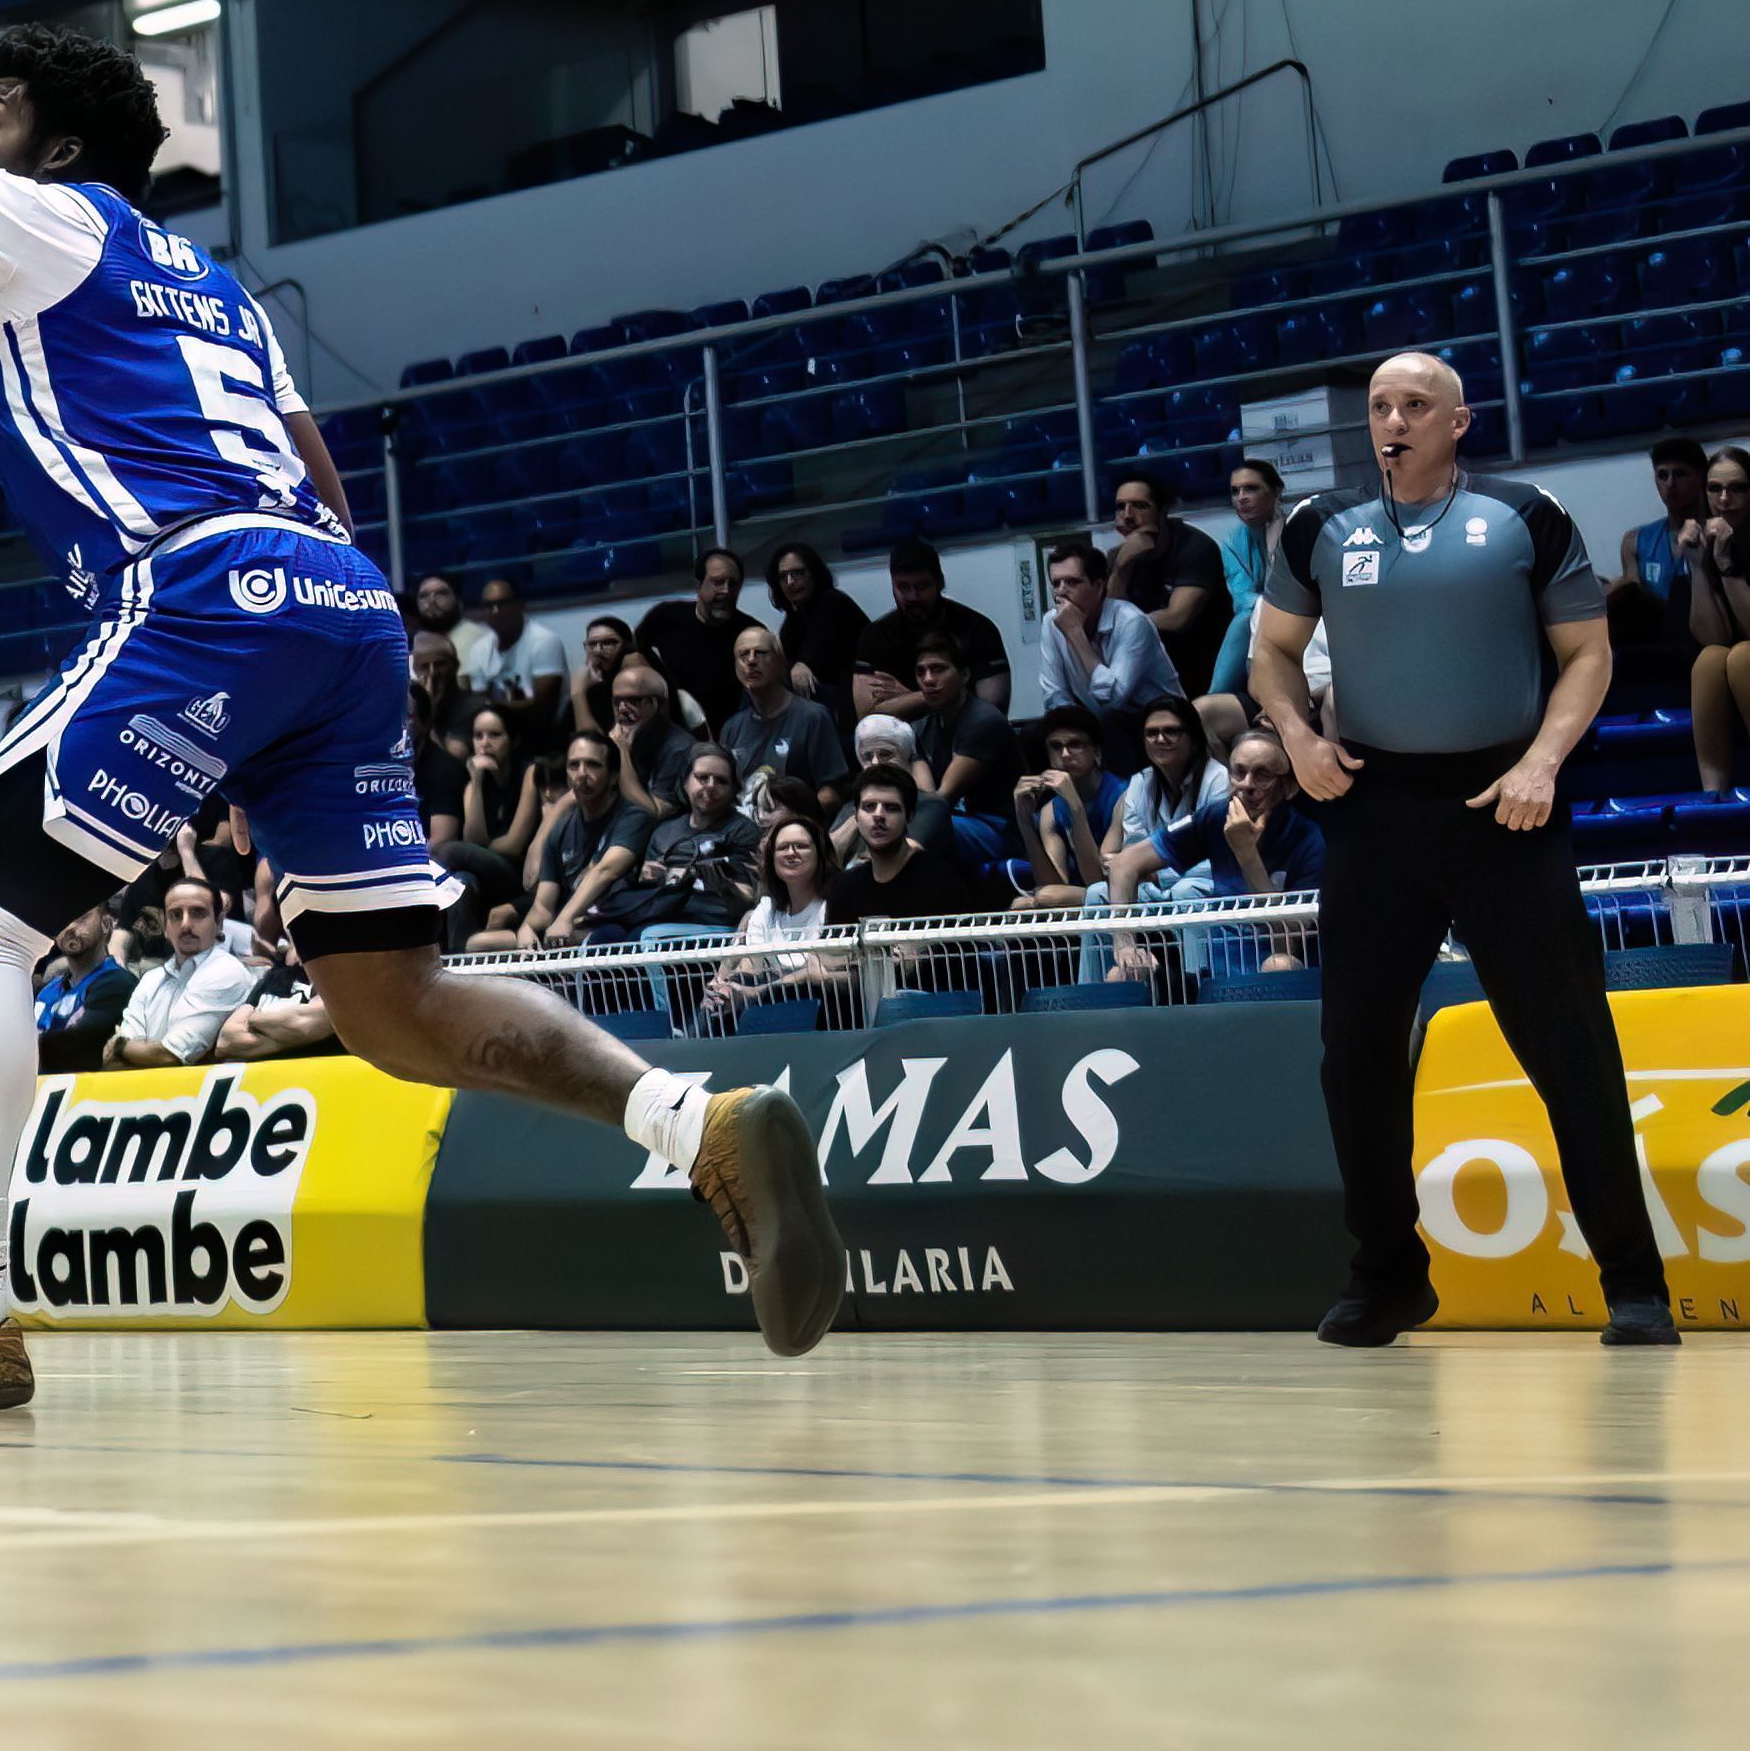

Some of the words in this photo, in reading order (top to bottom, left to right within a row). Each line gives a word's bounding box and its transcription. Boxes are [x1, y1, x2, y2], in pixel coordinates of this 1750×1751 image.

[131, 280, 230, 337] GITTENS
[176, 335, 306, 490] 5
[87, 768, 189, 840] PHOLIA
[26, 1076, 308, 1186] lambe
[9, 1189, 285, 1307] lambe
[719, 1247, 1015, 1296] DILARIA
[1531, 1293, 1740, 1321] ALEN
